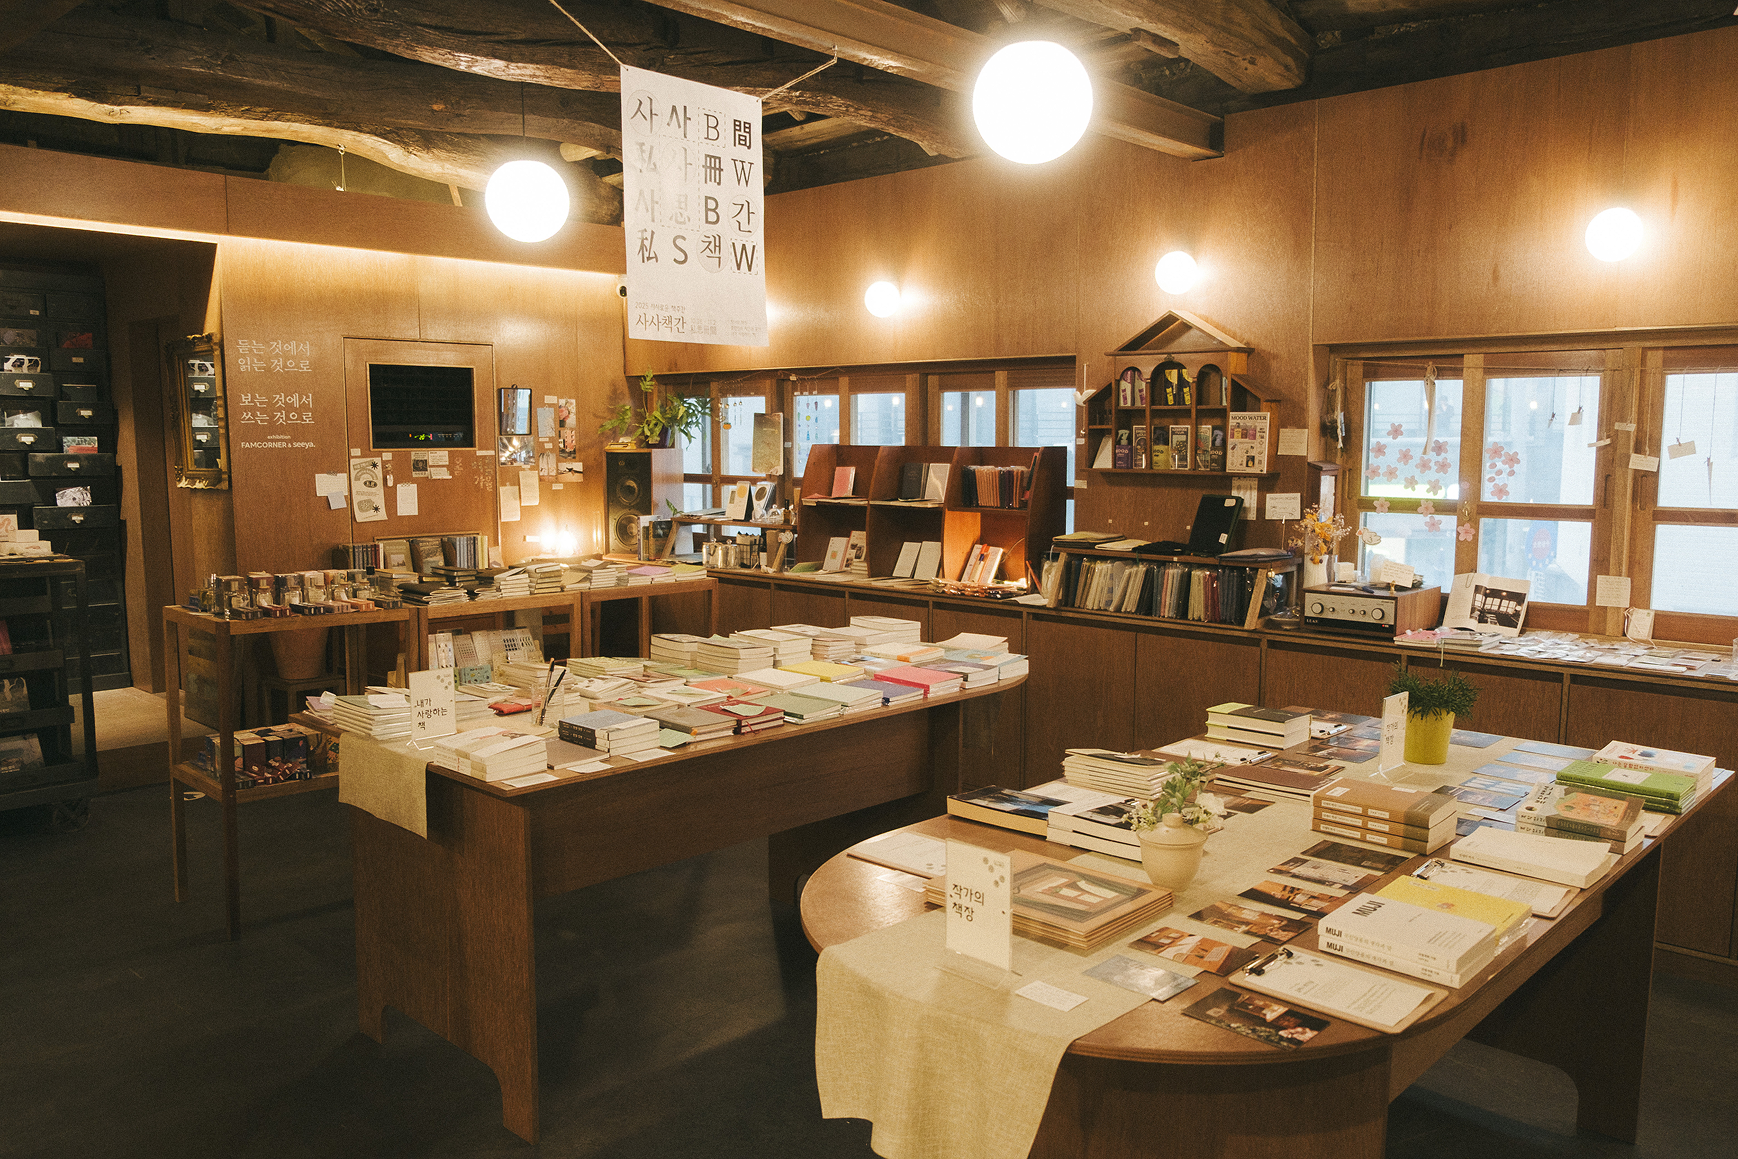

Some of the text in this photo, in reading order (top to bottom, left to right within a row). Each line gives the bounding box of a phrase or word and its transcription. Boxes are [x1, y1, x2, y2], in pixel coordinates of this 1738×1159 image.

[635, 312, 687, 334] 사사책간
[237, 339, 310, 357] 듣는 것에서
[237, 356, 313, 373] 읽는 것으로
[239, 392, 313, 409] 보는 것에서
[240, 410, 315, 426] 쓰는 것으로
[241, 441, 287, 449] FAMCORNER
[415, 698, 431, 707] 내가
[416, 708, 448, 718] 사랑하는
[417, 721, 426, 730] 책
[952, 883, 985, 906] 작가의
[952, 902, 974, 922] 책장
[1352, 900, 1386, 917] MUJI
[1325, 926, 1343, 938] MUJI
[1326, 941, 1344, 953] MUJI
